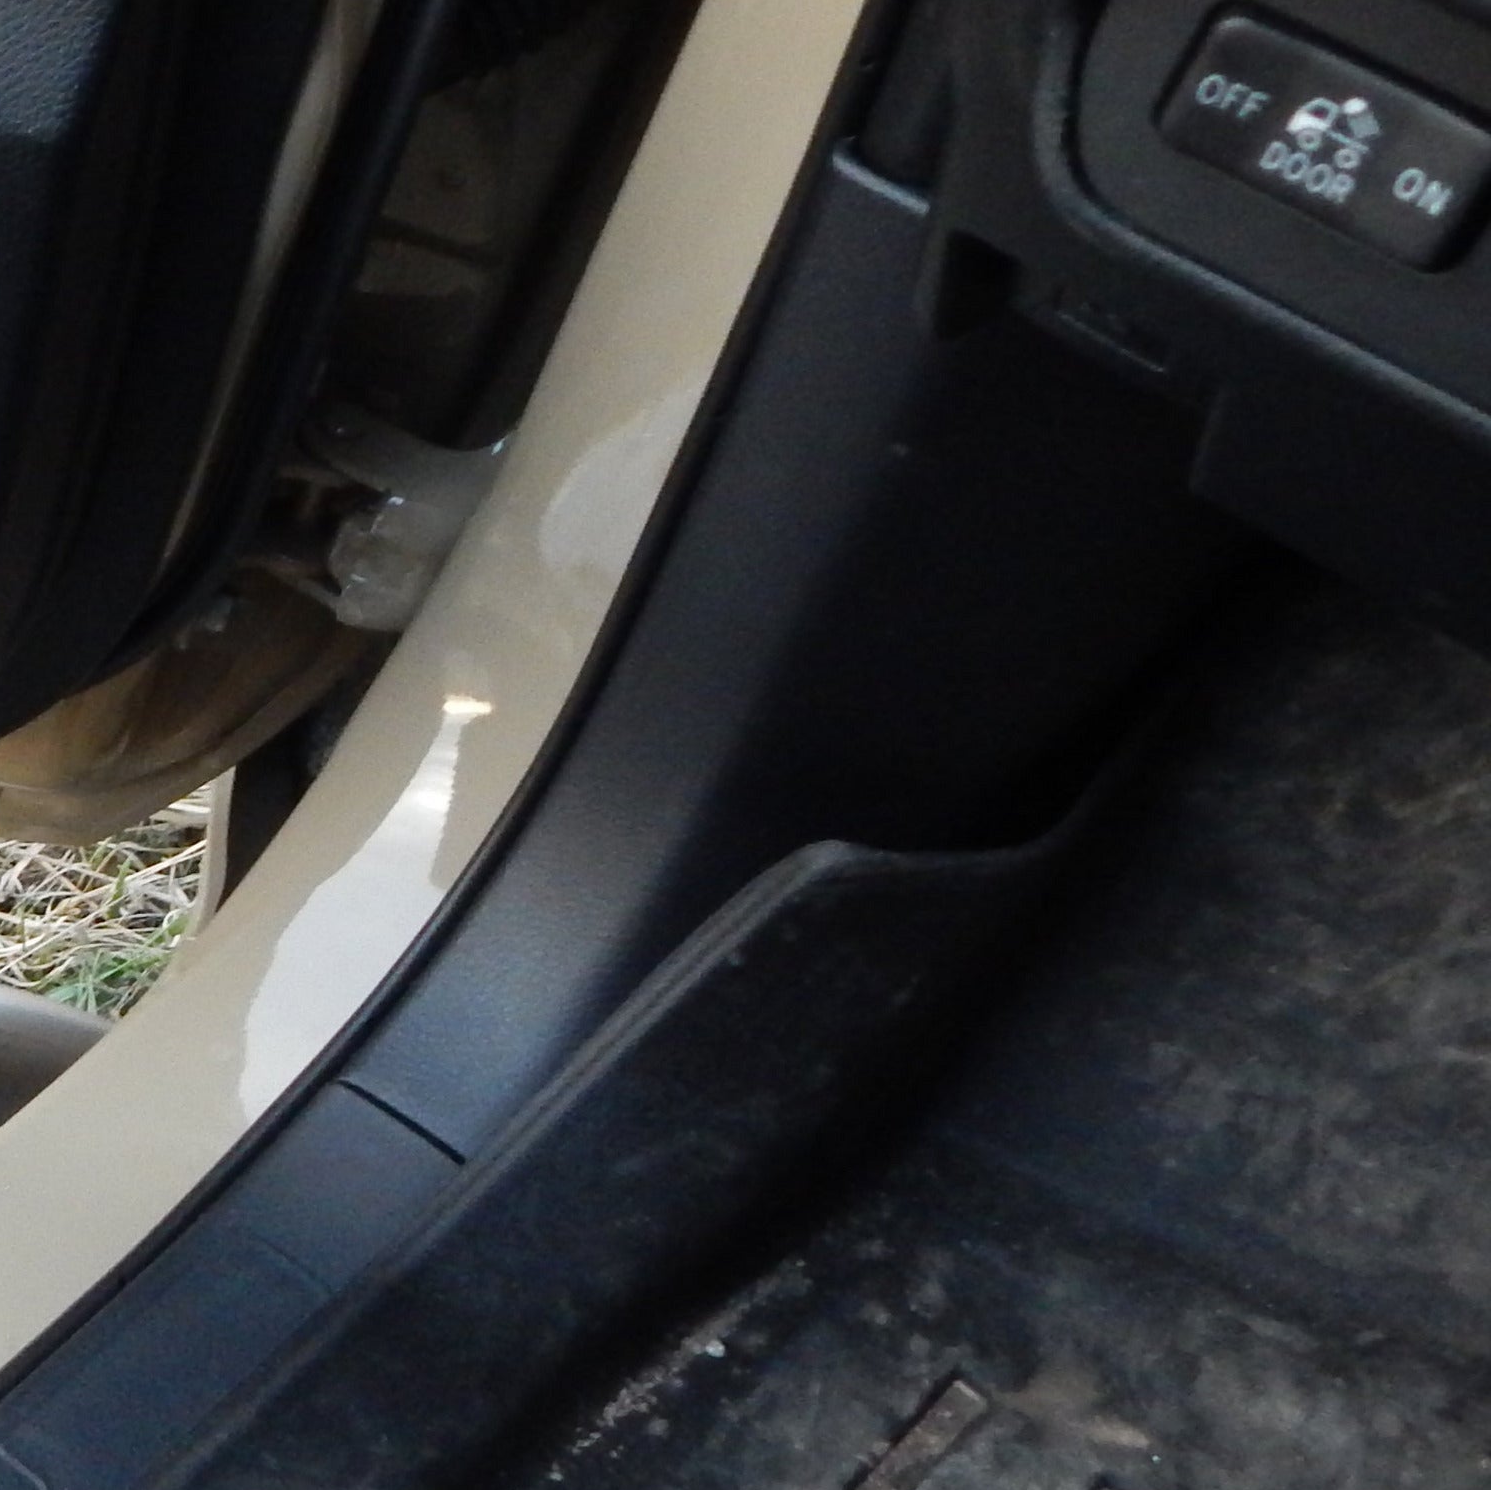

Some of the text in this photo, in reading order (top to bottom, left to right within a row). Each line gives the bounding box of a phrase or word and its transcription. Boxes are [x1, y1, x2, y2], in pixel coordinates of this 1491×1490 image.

[1195, 74, 1270, 118] OFF
[1259, 141, 1357, 203] DOOR
[1392, 167, 1454, 216] ON
